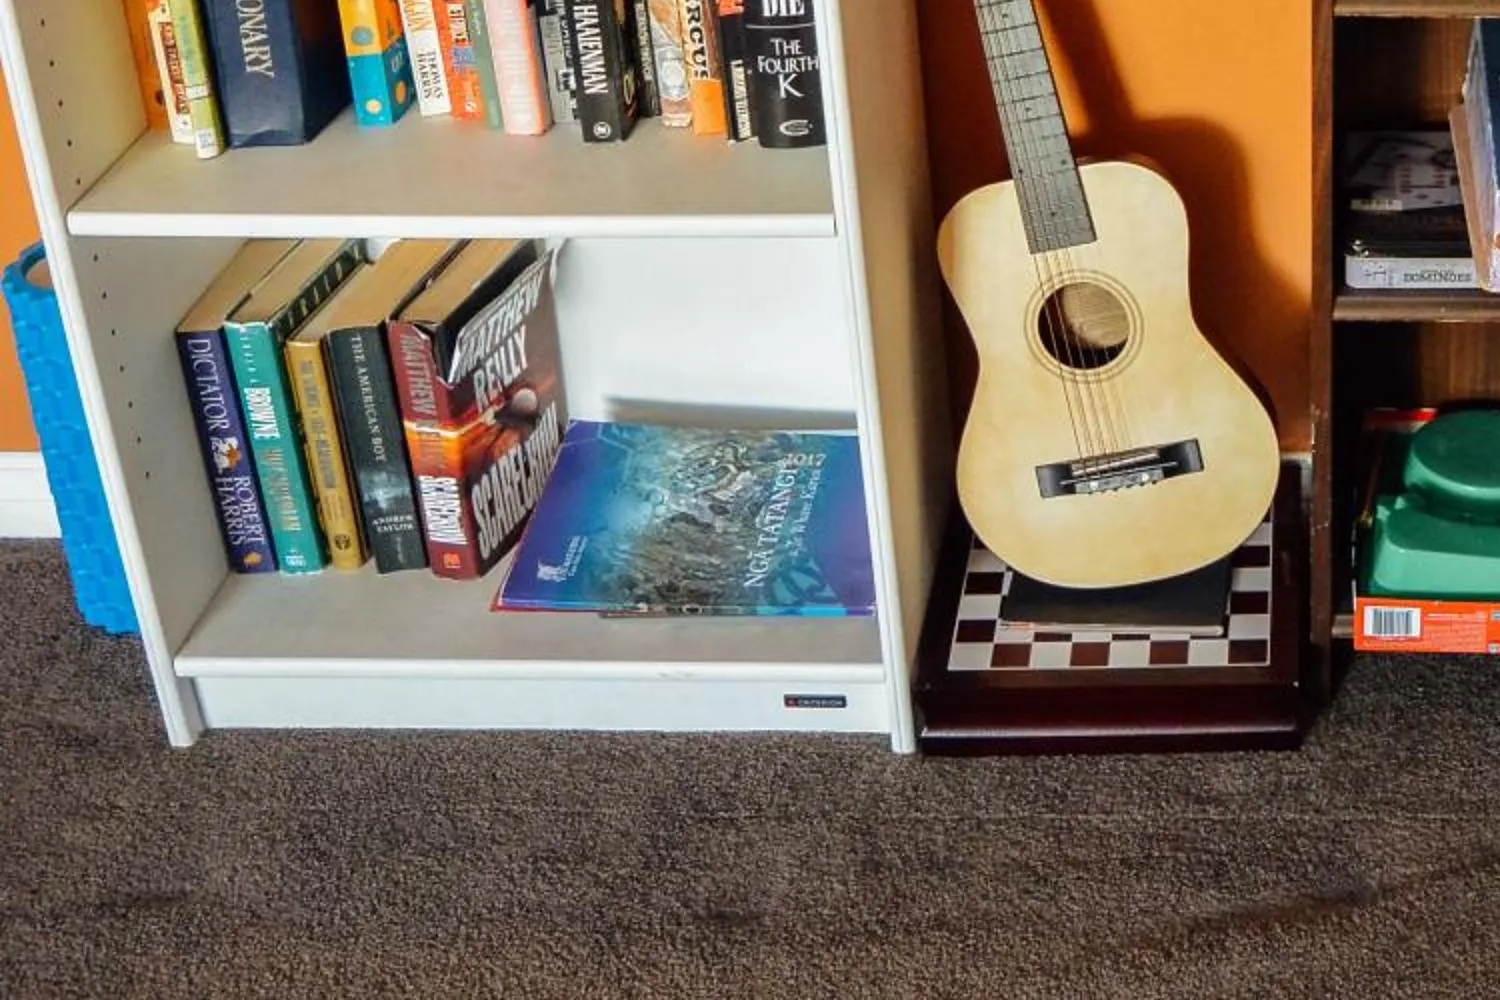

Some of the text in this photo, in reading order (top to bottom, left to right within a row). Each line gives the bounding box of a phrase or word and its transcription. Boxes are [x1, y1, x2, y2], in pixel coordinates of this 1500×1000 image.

[416, 52, 432, 100] HARRIS
[425, 50, 443, 100] THOMAS
[574, 4, 609, 95] HAAIENMAN
[757, 54, 822, 74] FOURTH
[769, 37, 804, 56] THE
[779, 72, 805, 98] K
[449, 264, 545, 383] MATTHEW
[187, 338, 230, 431] DICTATOR
[350, 336, 386, 463] THE AMERICAN BOY
[399, 333, 435, 415] MATTHEW
[473, 324, 528, 412] REILLY
[243, 387, 281, 440] BROWNE
[214, 477, 247, 548] HARRIS
[234, 475, 266, 546] ROBERT
[470, 402, 560, 561] SCARECROW
